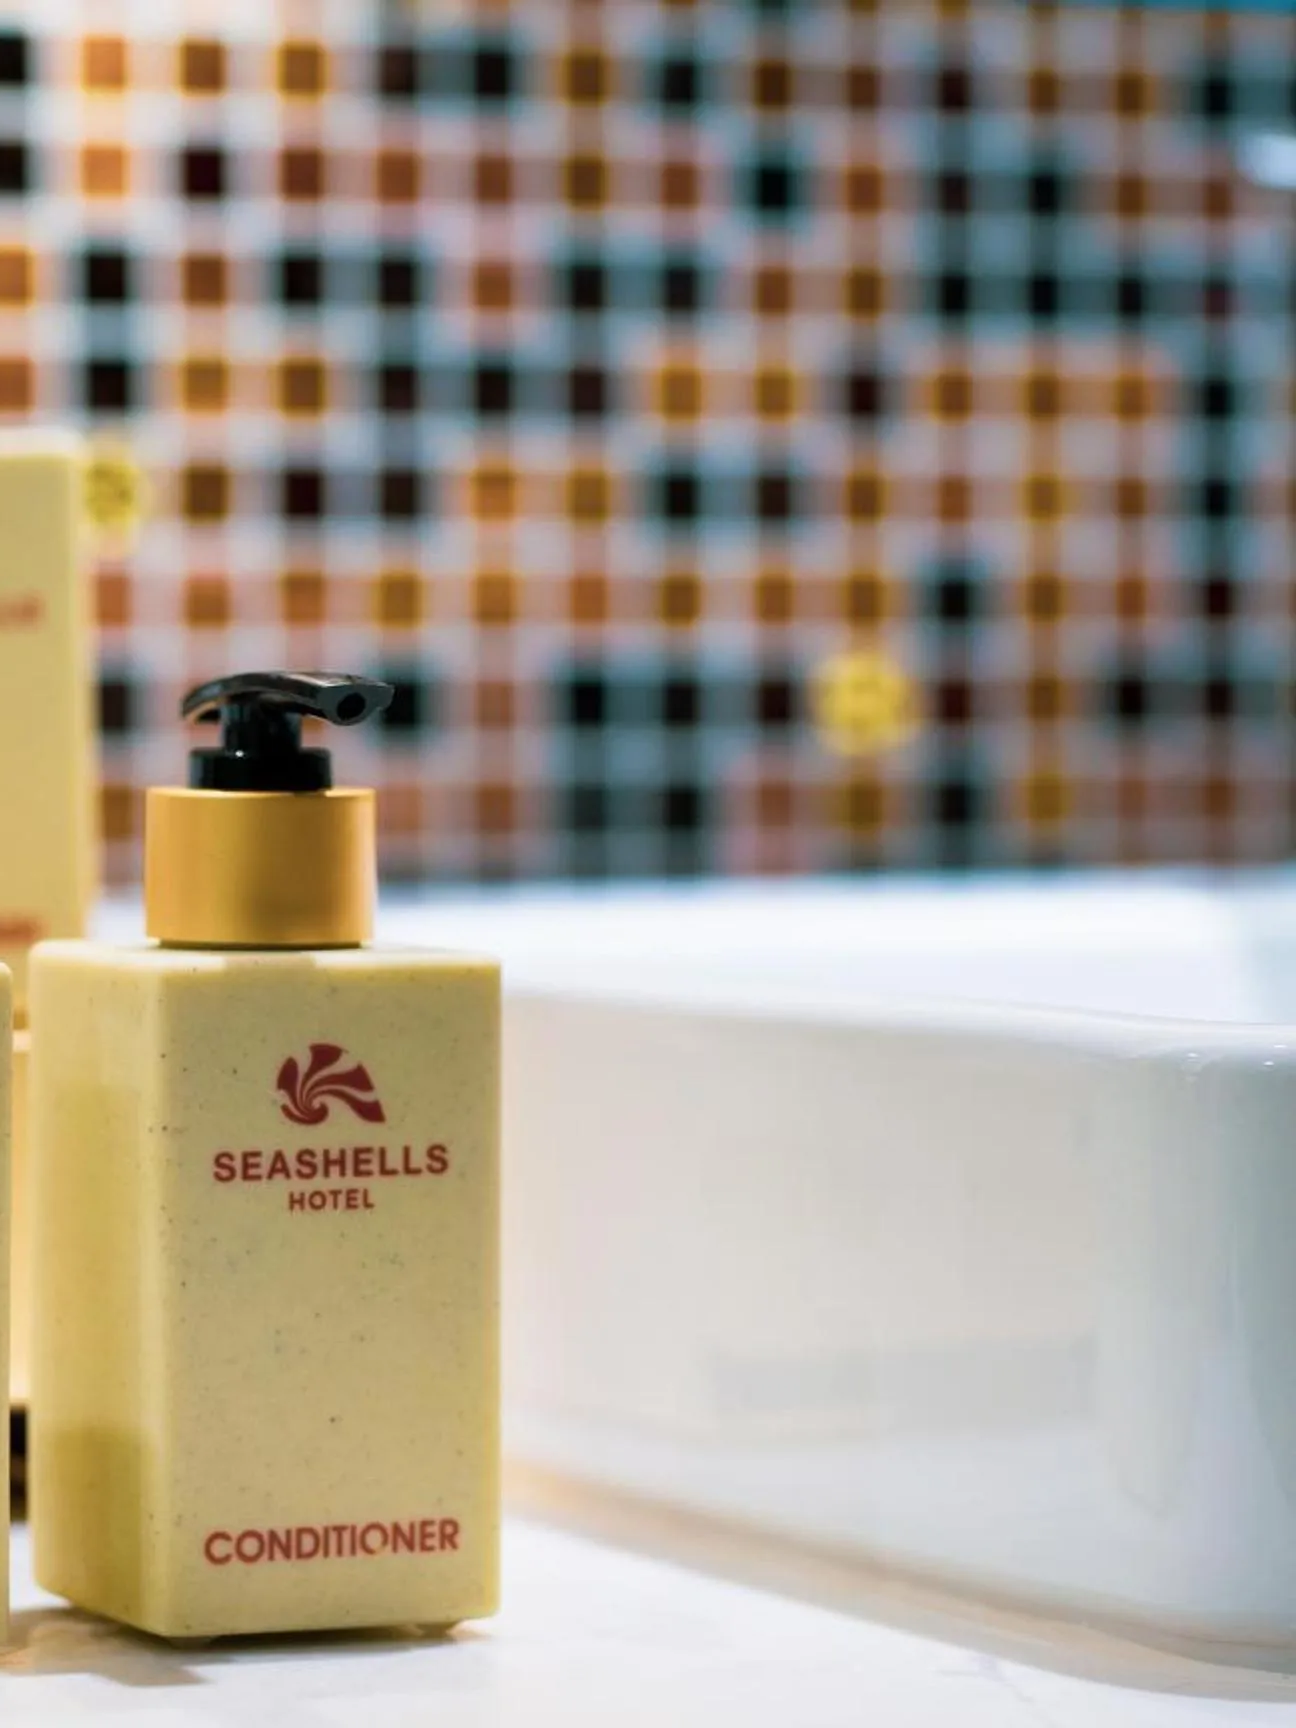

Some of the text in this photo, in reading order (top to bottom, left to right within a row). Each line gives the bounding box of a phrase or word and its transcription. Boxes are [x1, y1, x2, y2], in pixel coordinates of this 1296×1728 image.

[214, 1144, 448, 1183] SEASHELLS
[289, 1189, 375, 1211] HOTEL
[205, 1518, 460, 1565] CONDITIONER
